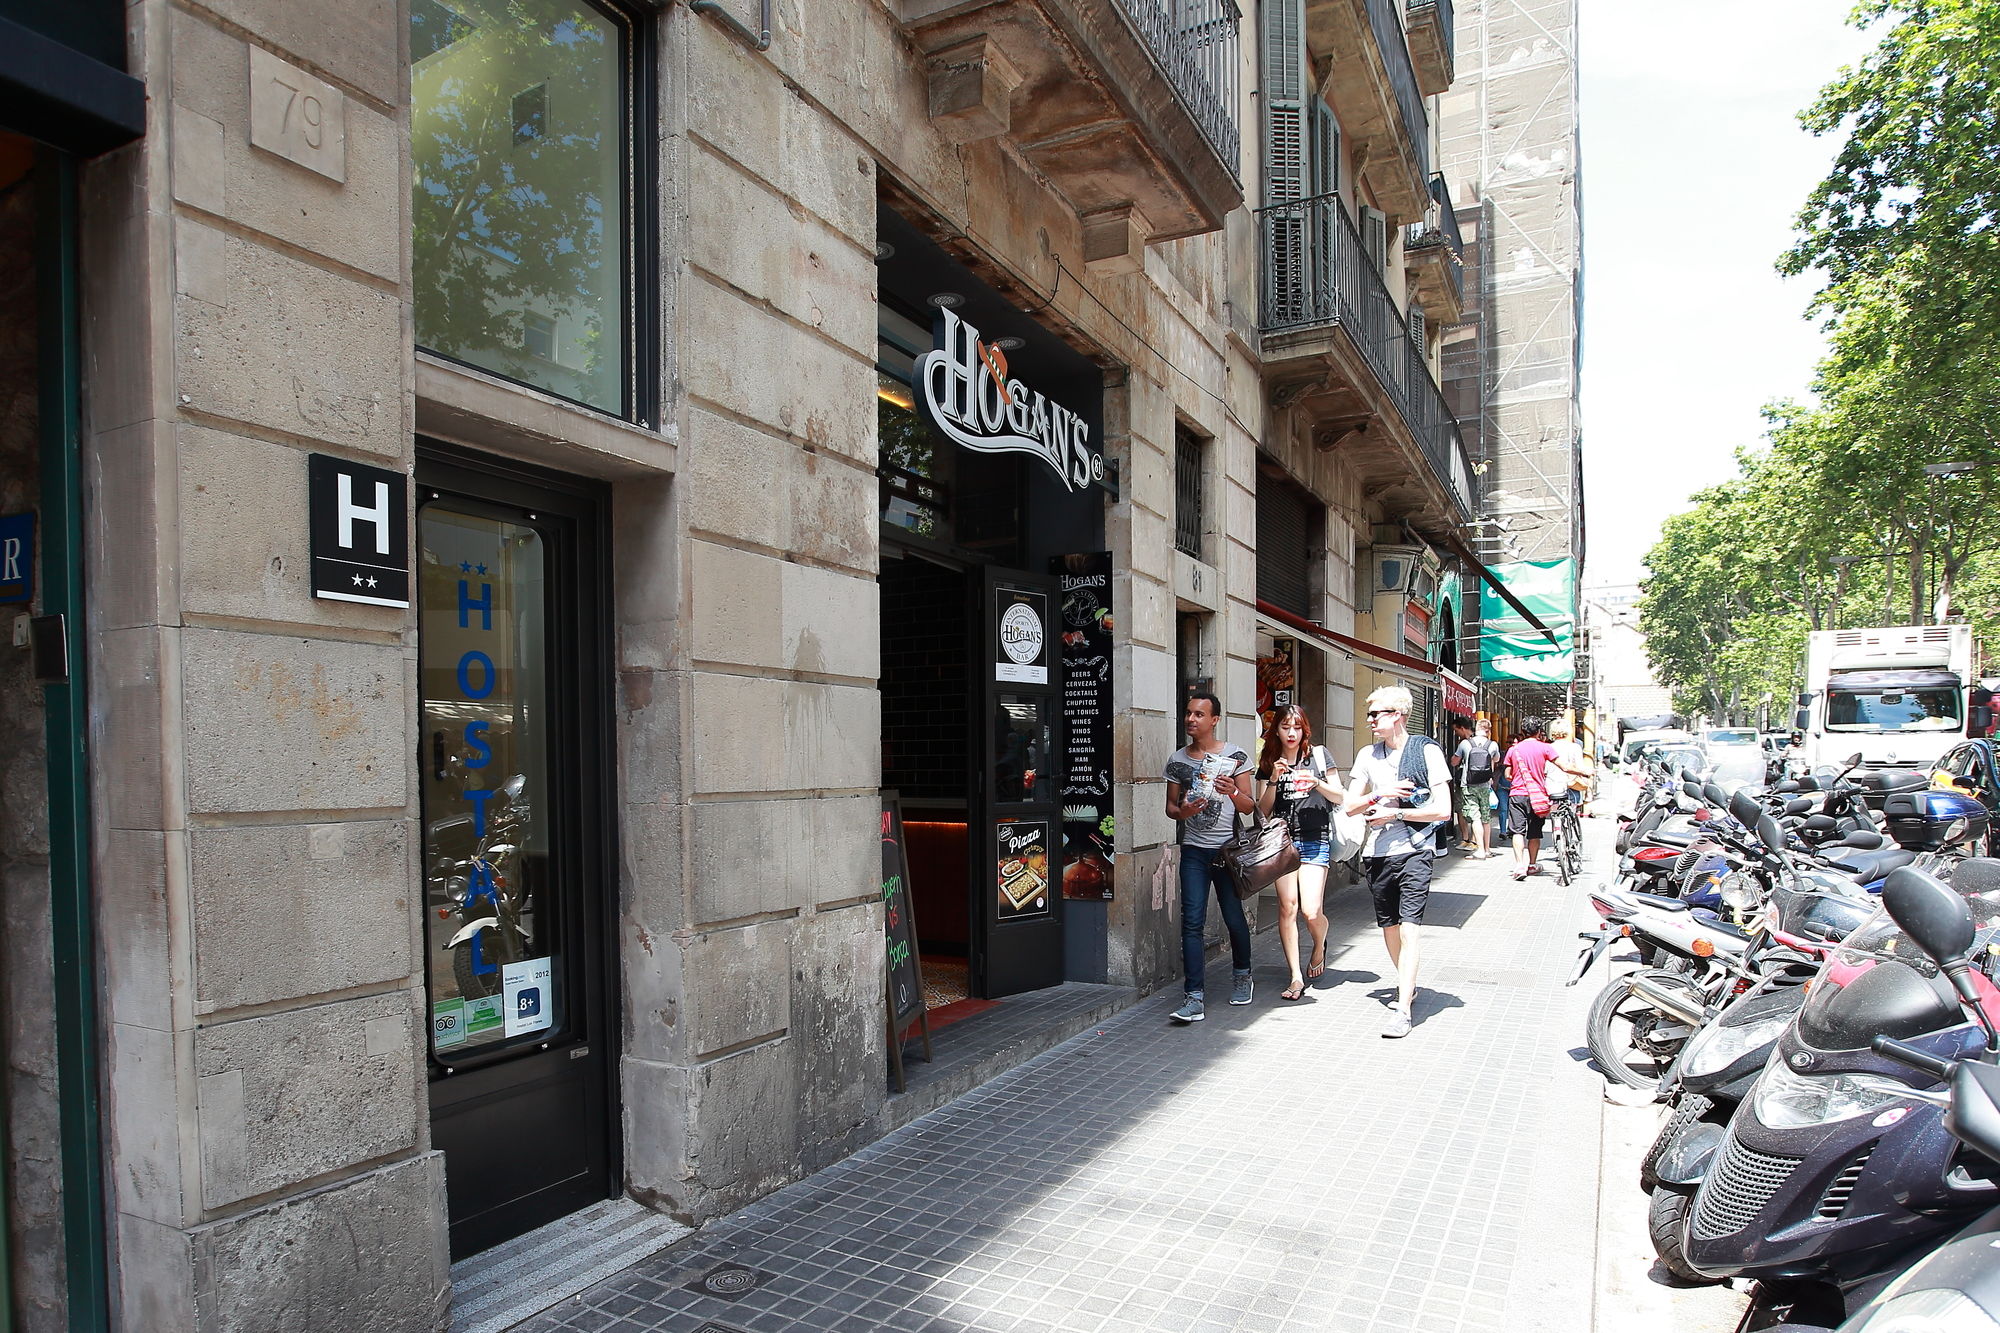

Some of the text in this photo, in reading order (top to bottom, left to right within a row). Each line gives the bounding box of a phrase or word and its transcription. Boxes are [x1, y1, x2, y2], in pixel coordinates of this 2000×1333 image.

[270, 77, 323, 151] 79
[924, 306, 1092, 493] HOGAN'S
[337, 472, 390, 555] H
[2, 537, 22, 581] R
[1061, 574, 1106, 589] HOGAN'S
[1002, 624, 1041, 645] HOGAN'S
[1016, 653, 1029, 661] BAR
[457, 580, 497, 976] HOSTAL
[1009, 829, 1041, 854] Pizza
[535, 970, 549, 979] 2012
[520, 998, 534, 1011] 8+
